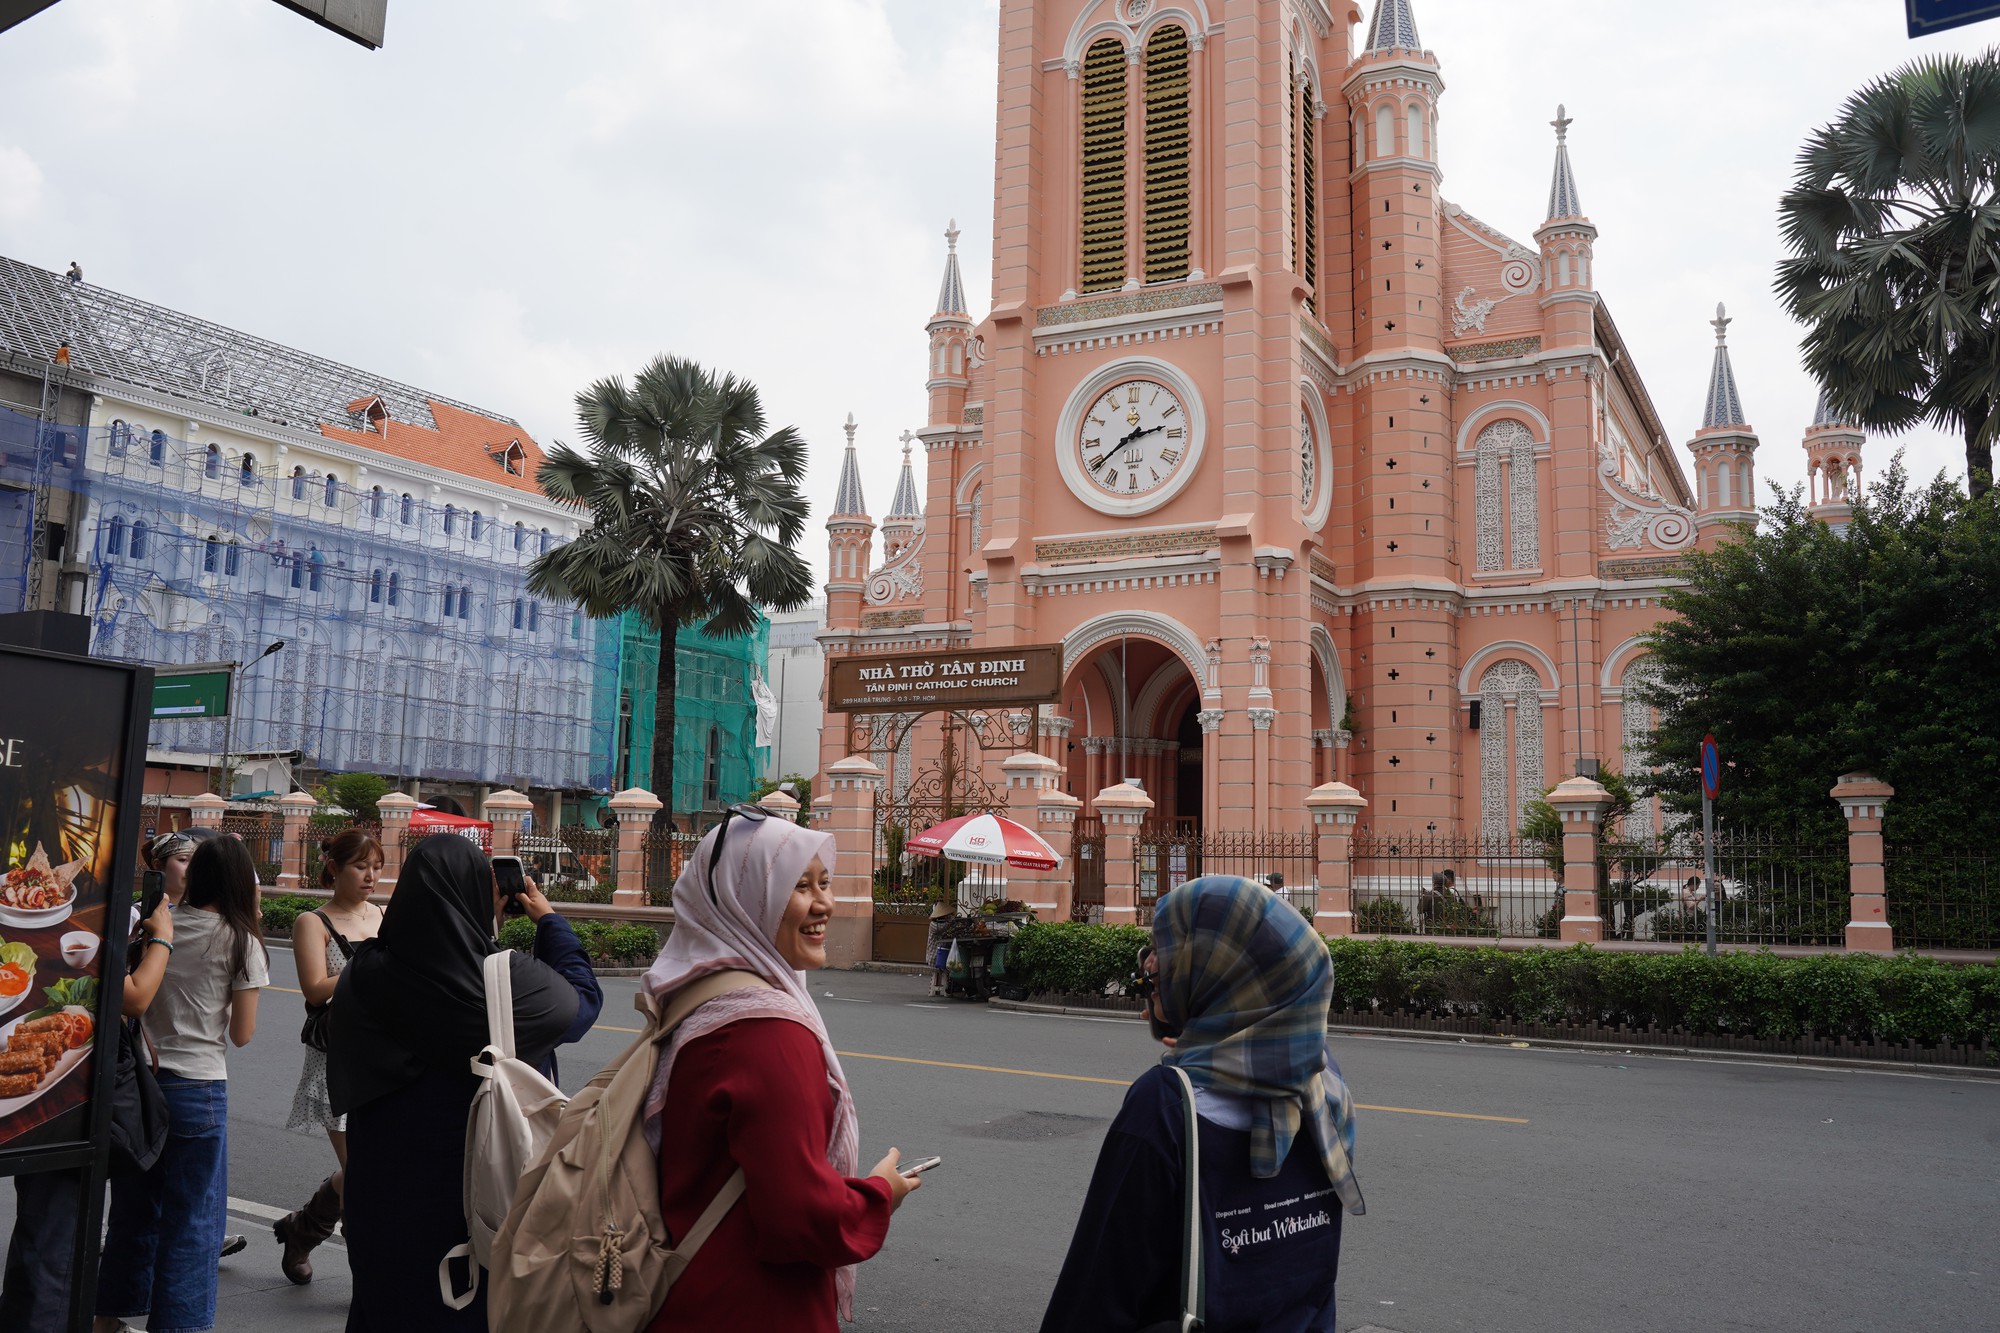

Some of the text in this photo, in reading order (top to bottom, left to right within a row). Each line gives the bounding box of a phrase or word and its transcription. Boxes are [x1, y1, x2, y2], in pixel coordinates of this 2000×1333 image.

[1128, 387, 1140, 403] XII
[1167, 427, 1182, 439] III
[859, 659, 1025, 680] NHÀ THỜ TÂN ĐỊNH
[865, 677, 1018, 693] TÂN ĐỊNH CATHOLIC CHURCH
[1221, 1228, 1250, 1249] Soft
[1251, 1227, 1272, 1244] but
